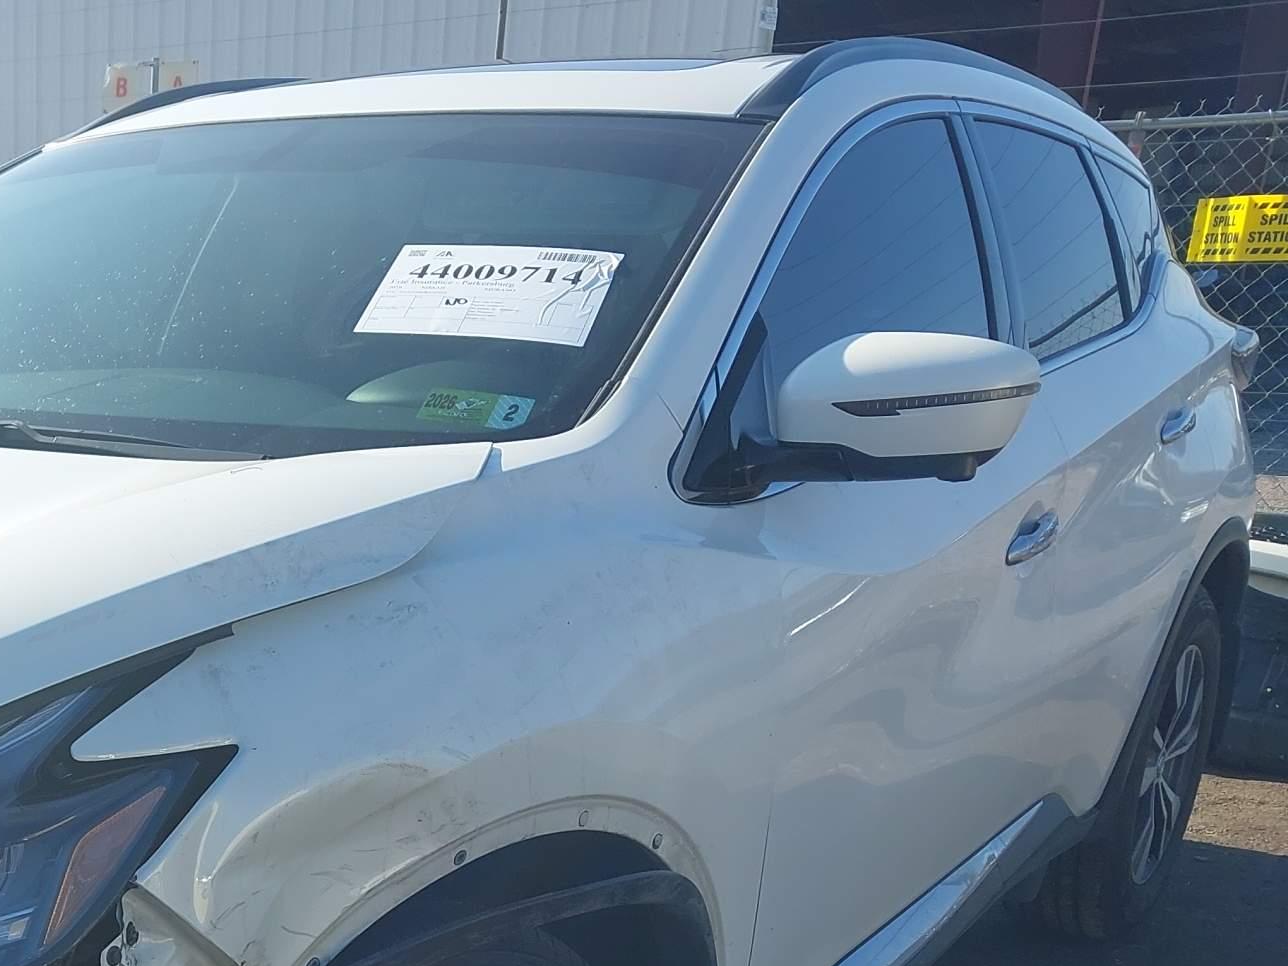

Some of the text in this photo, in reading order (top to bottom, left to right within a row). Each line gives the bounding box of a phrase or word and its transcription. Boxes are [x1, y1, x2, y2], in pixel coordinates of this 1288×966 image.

[116, 77, 127, 97] B
[1212, 216, 1236, 227] SPILL
[1204, 232, 1239, 244] STATION
[408, 263, 583, 285] 44009714
[503, 404, 519, 422] 2
